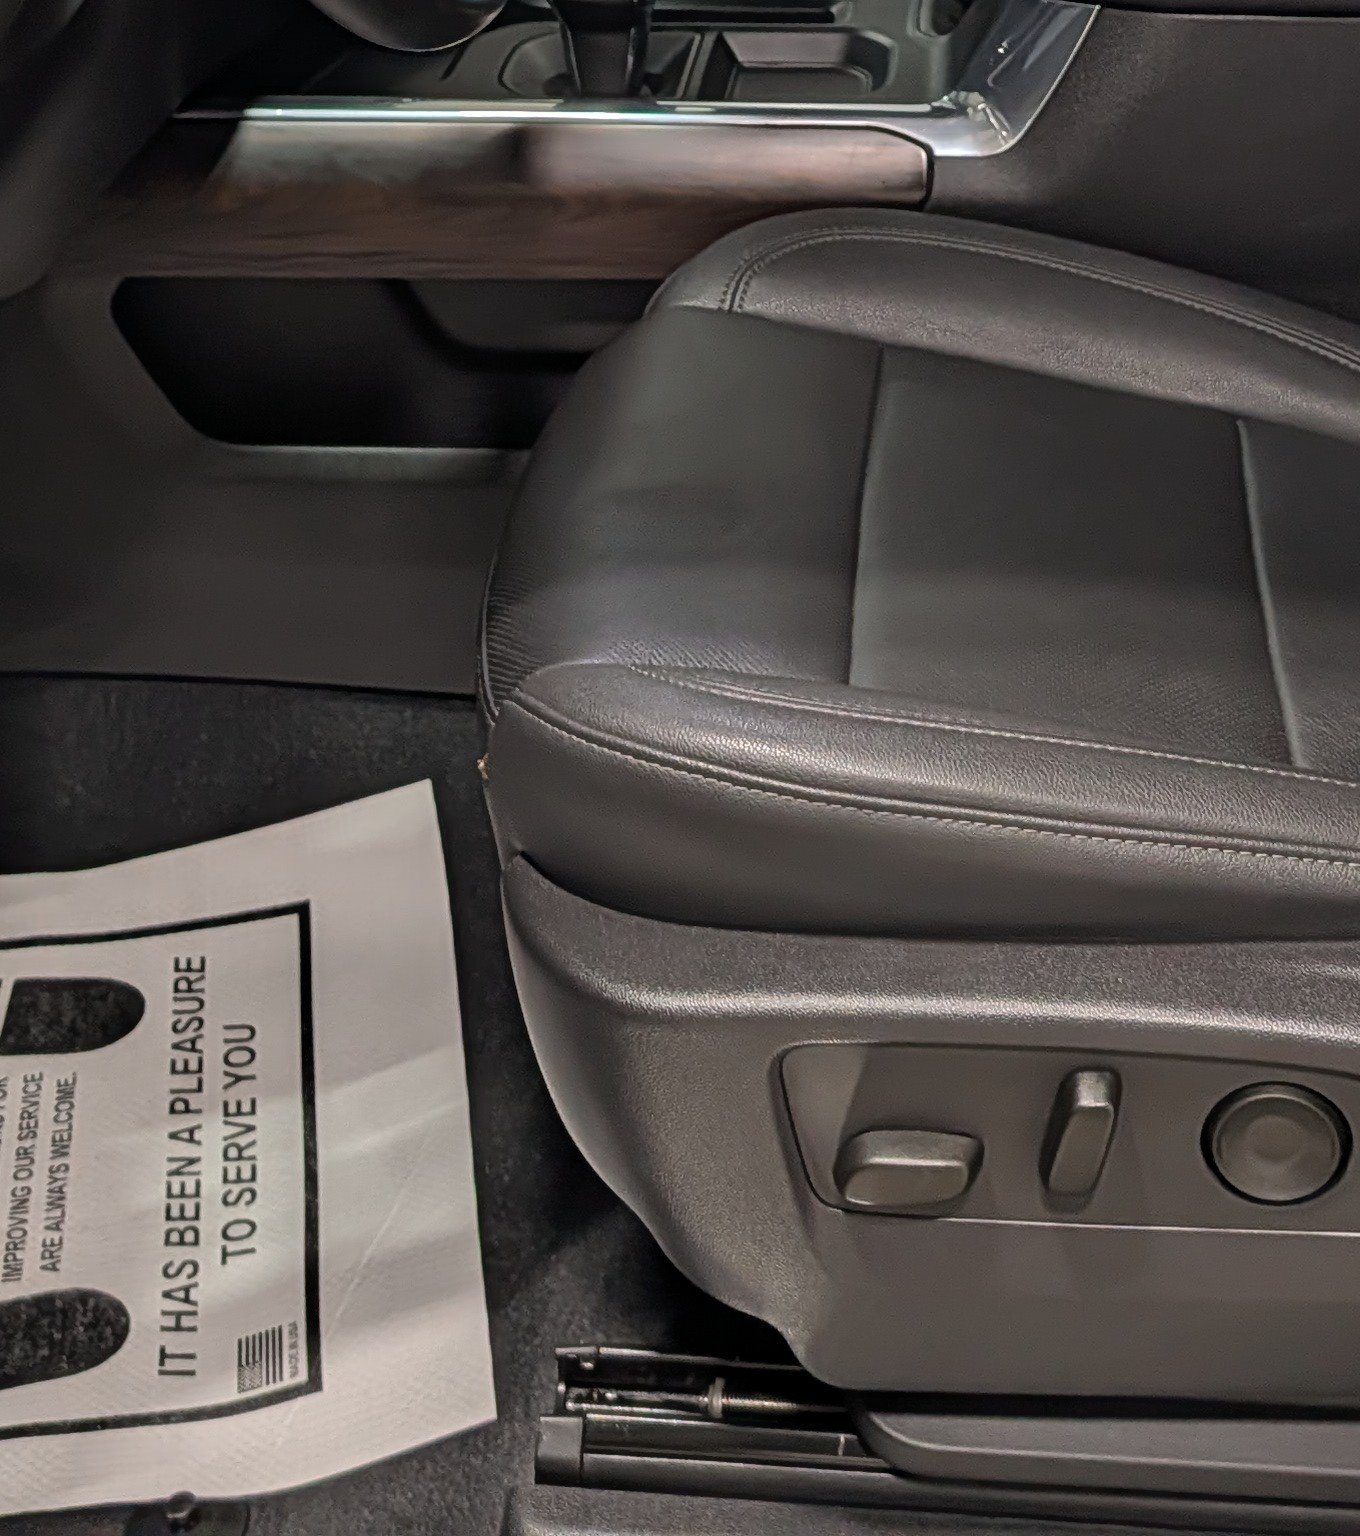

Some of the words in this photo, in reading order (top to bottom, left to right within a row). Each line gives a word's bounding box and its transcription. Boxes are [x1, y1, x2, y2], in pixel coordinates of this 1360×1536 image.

[168, 955, 206, 1114] PLEASURE
[222, 1024, 257, 1090] YOU
[17, 1071, 43, 1142] SERVICE
[49, 1072, 77, 1161] WELCOME.
[167, 1123, 203, 1145] A
[13, 1144, 35, 1182] OUR
[221, 1097, 257, 1206] SERVE
[43, 1162, 70, 1233] ALWAYS
[163, 1156, 202, 1247] BEEN
[1, 1185, 32, 1283] IMPROVING
[40, 1235, 63, 1273] ARE
[220, 1218, 257, 1265] TO
[160, 1259, 199, 1332] HAS
[158, 1345, 197, 1376] IT
